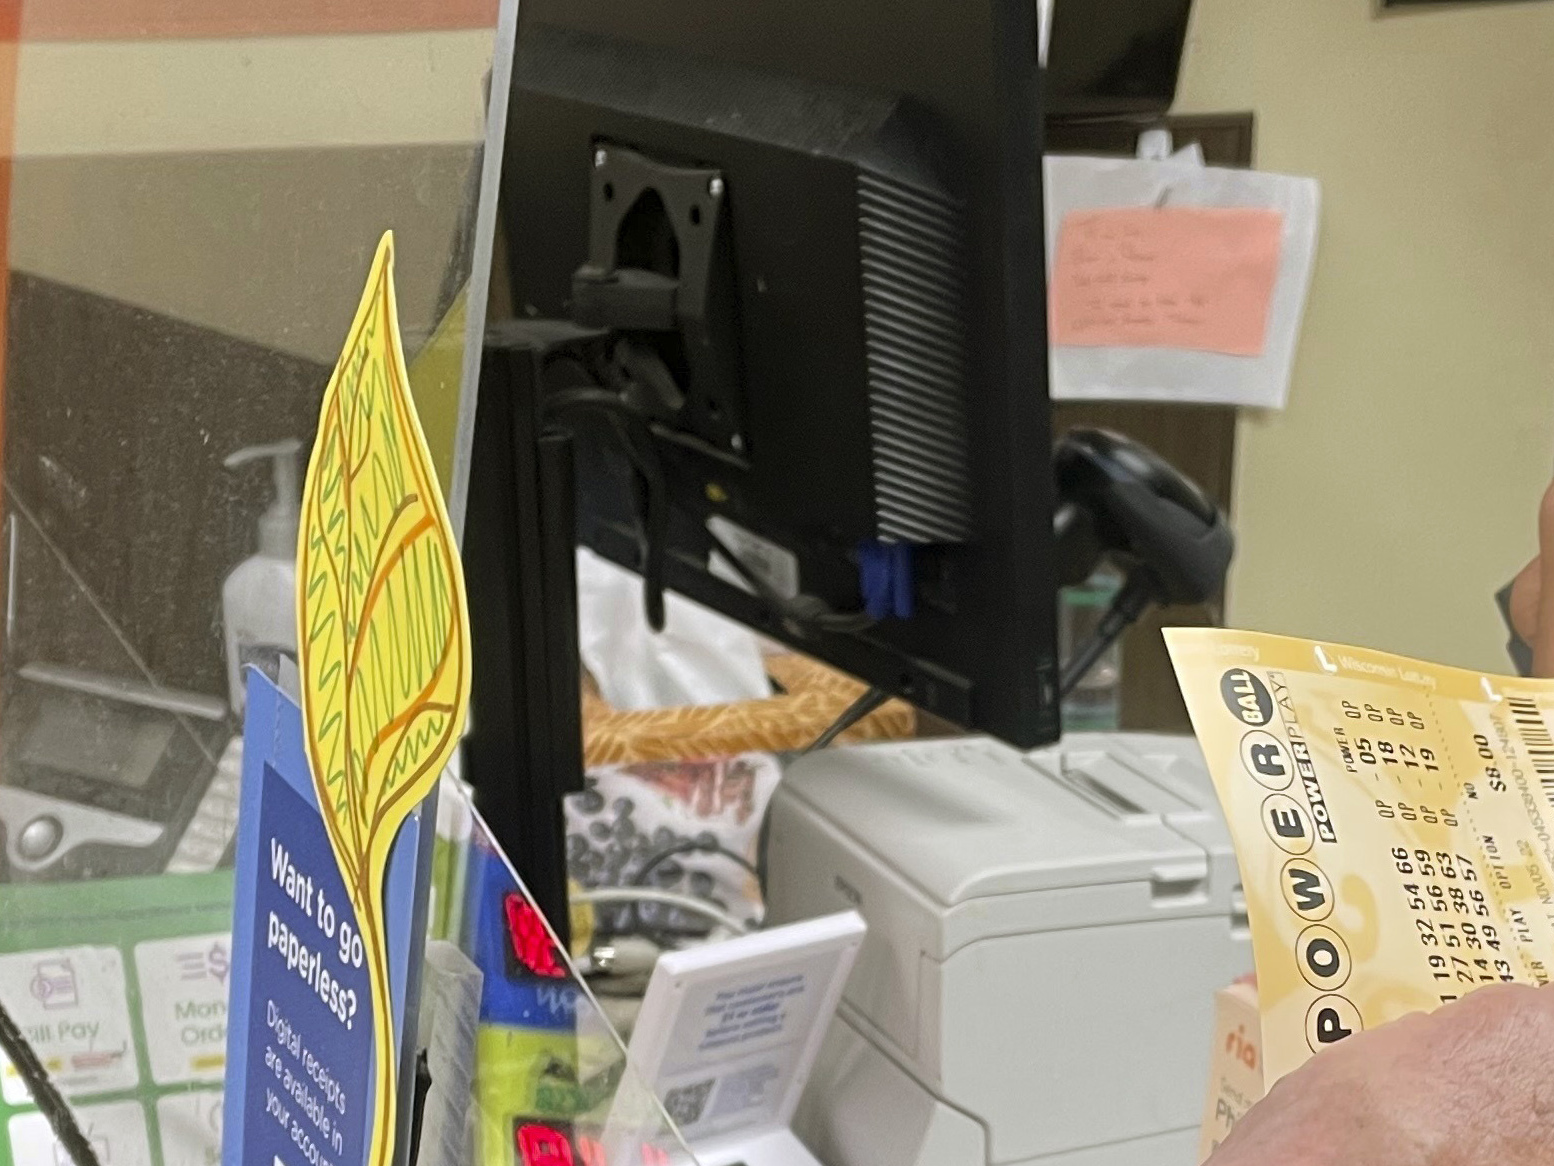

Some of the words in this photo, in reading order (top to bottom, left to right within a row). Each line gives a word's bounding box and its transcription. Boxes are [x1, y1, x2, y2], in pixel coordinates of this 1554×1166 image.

[1333, 726, 1359, 774] POWER
[1359, 737, 1377, 766] 05
[1377, 741, 1399, 766] 18
[1399, 744, 1420, 770] 12
[1419, 747, 1440, 773] 19
[1473, 732, 1508, 794] $8.00
[1462, 781, 1480, 800] NO
[1391, 847, 1414, 875] 66
[1414, 849, 1436, 878] 59
[1436, 851, 1458, 880] 63
[1456, 853, 1479, 882] 57
[1481, 834, 1513, 891] OPTION
[270, 836, 314, 918] Want
[317, 888, 335, 939] to
[338, 919, 363, 969] go
[1403, 883, 1426, 911] 54
[1426, 885, 1448, 913] 56
[1448, 887, 1470, 914] 38
[1469, 889, 1490, 918] 56
[1415, 917, 1439, 947] 32
[1439, 922, 1461, 948] 51
[1461, 922, 1483, 951] 30
[1481, 924, 1502, 952] 49
[1508, 907, 1535, 943] PLAY
[267, 910, 358, 1031] paperless?
[1429, 954, 1450, 982] 19
[1450, 956, 1475, 984] 27
[1471, 958, 1495, 982] 14
[57, 1019, 100, 1040] Pay
[265, 999, 301, 1058] Digital
[301, 1047, 347, 1116] receipts
[264, 1045, 283, 1079] are
[282, 1066, 330, 1140] available
[331, 1120, 344, 1156] in
[264, 1086, 291, 1129] your
